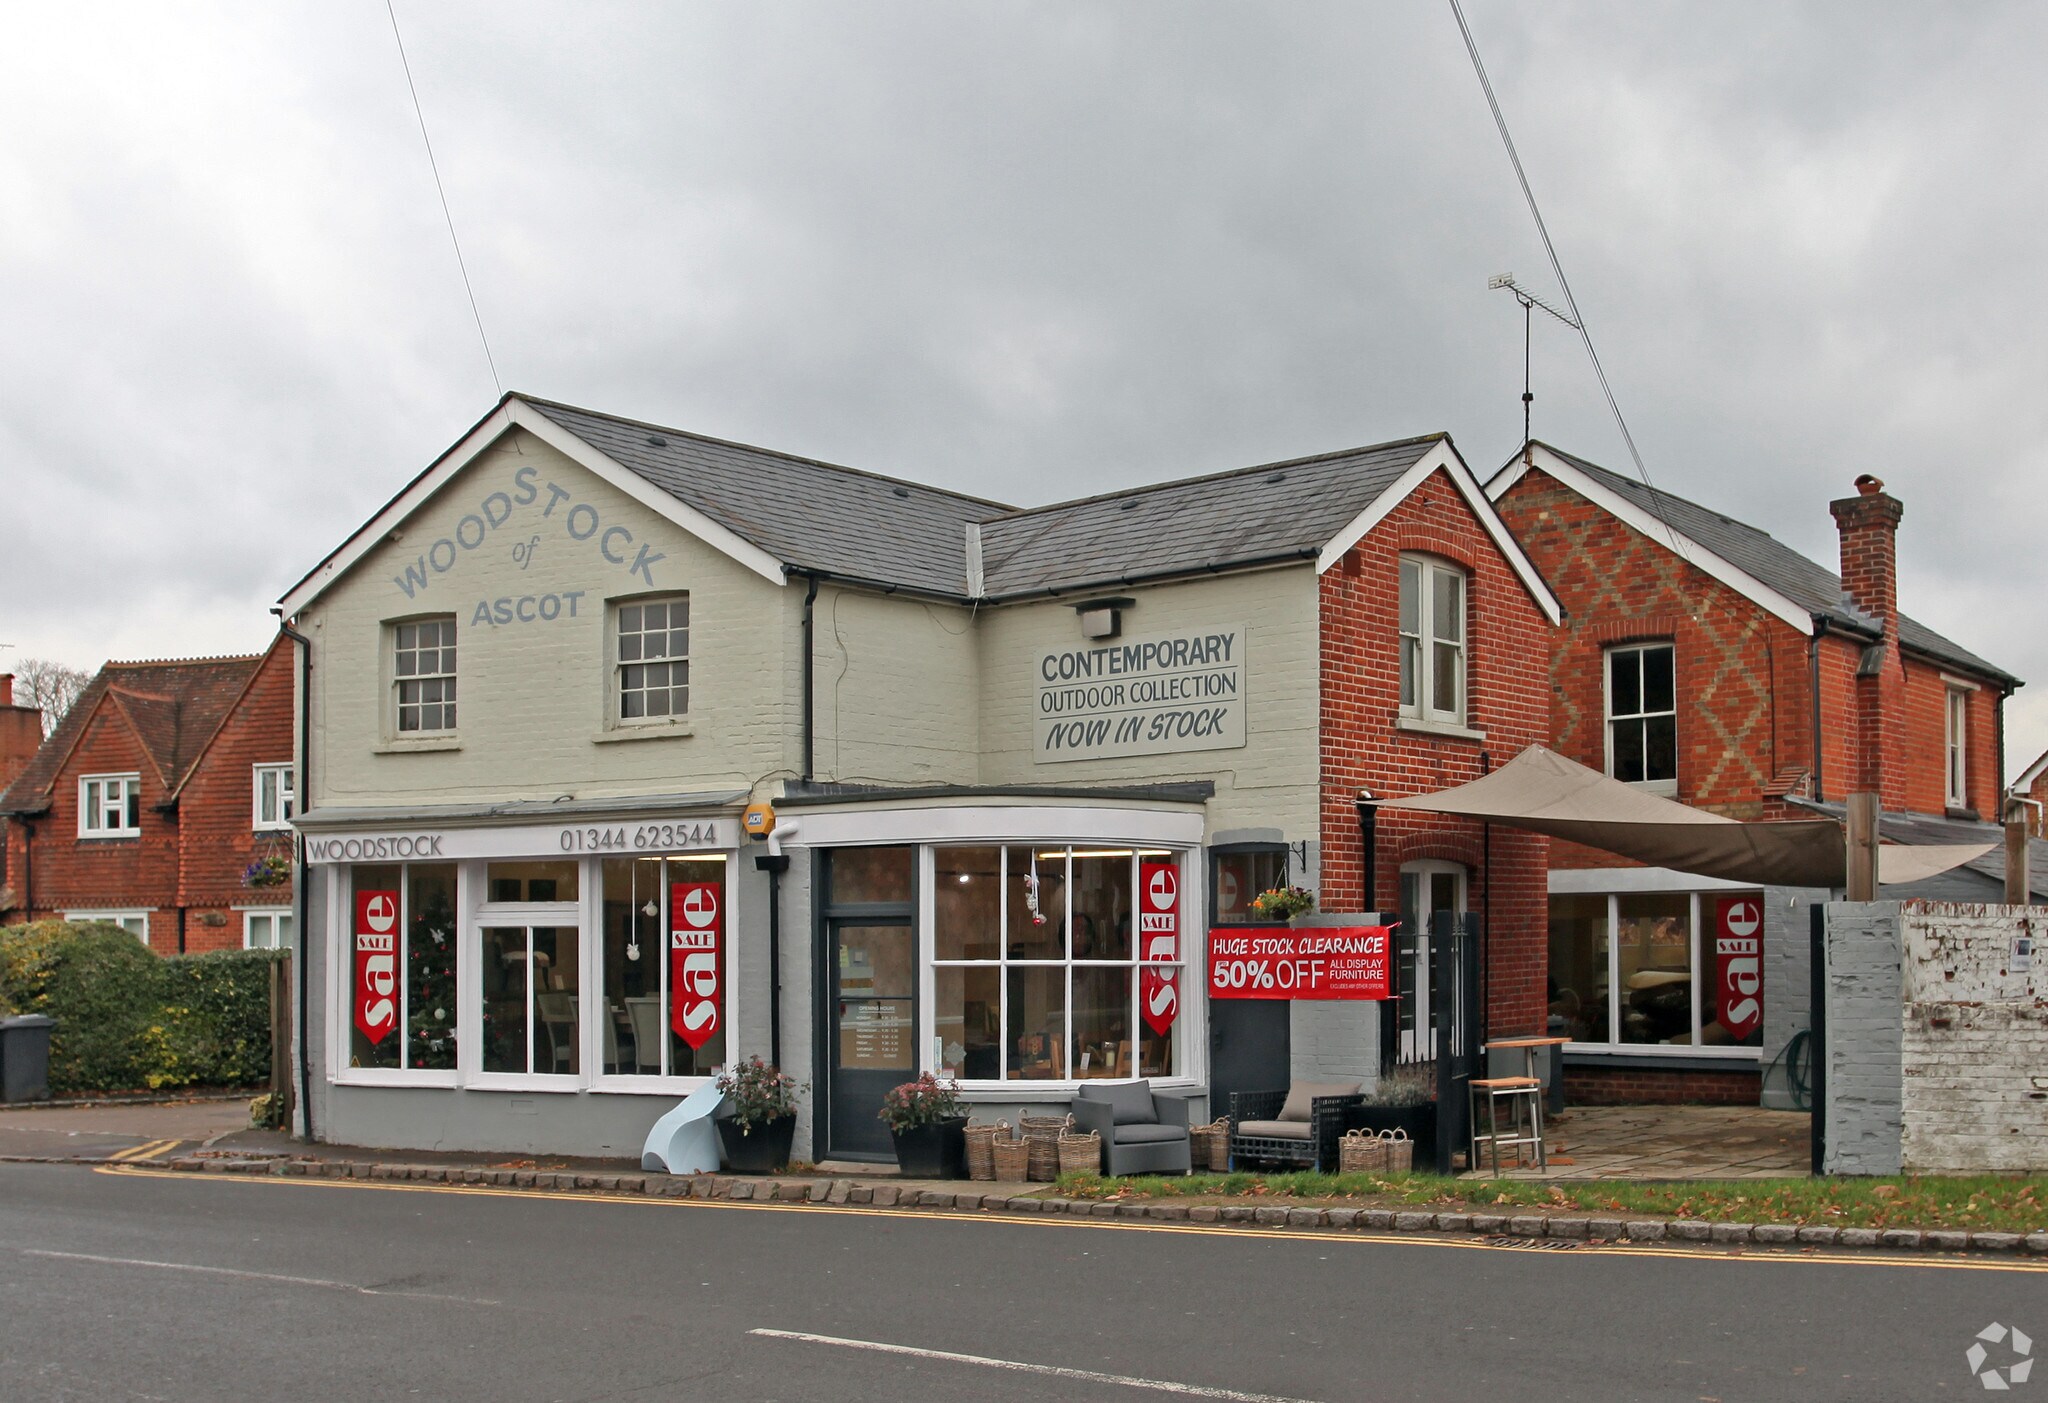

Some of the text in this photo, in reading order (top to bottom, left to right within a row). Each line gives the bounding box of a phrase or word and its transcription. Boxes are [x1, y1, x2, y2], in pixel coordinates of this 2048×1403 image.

[393, 467, 666, 599] WOODSTOCK
[512, 535, 540, 570] of
[471, 591, 585, 626] ASCOT
[1041, 632, 1235, 682] CONTEMPORARY
[1041, 671, 1236, 713] OUTDOOR COLLECTION
[1045, 708, 1228, 750] NOW IN STOCK
[748, 815, 762, 824] ADT
[308, 835, 443, 860] WOODSTOCK
[560, 823, 717, 852] 01344 623544
[1143, 916, 1172, 929] SALE
[359, 936, 390, 949] SALE
[674, 933, 712, 946] SALE
[1213, 937, 1384, 955] HUGE STOCK CLEARANCE
[1213, 959, 1325, 989] 50% OFF
[1329, 970, 1384, 980] FURNITURE
[1330, 959, 1383, 969] ALL DISPLAY
